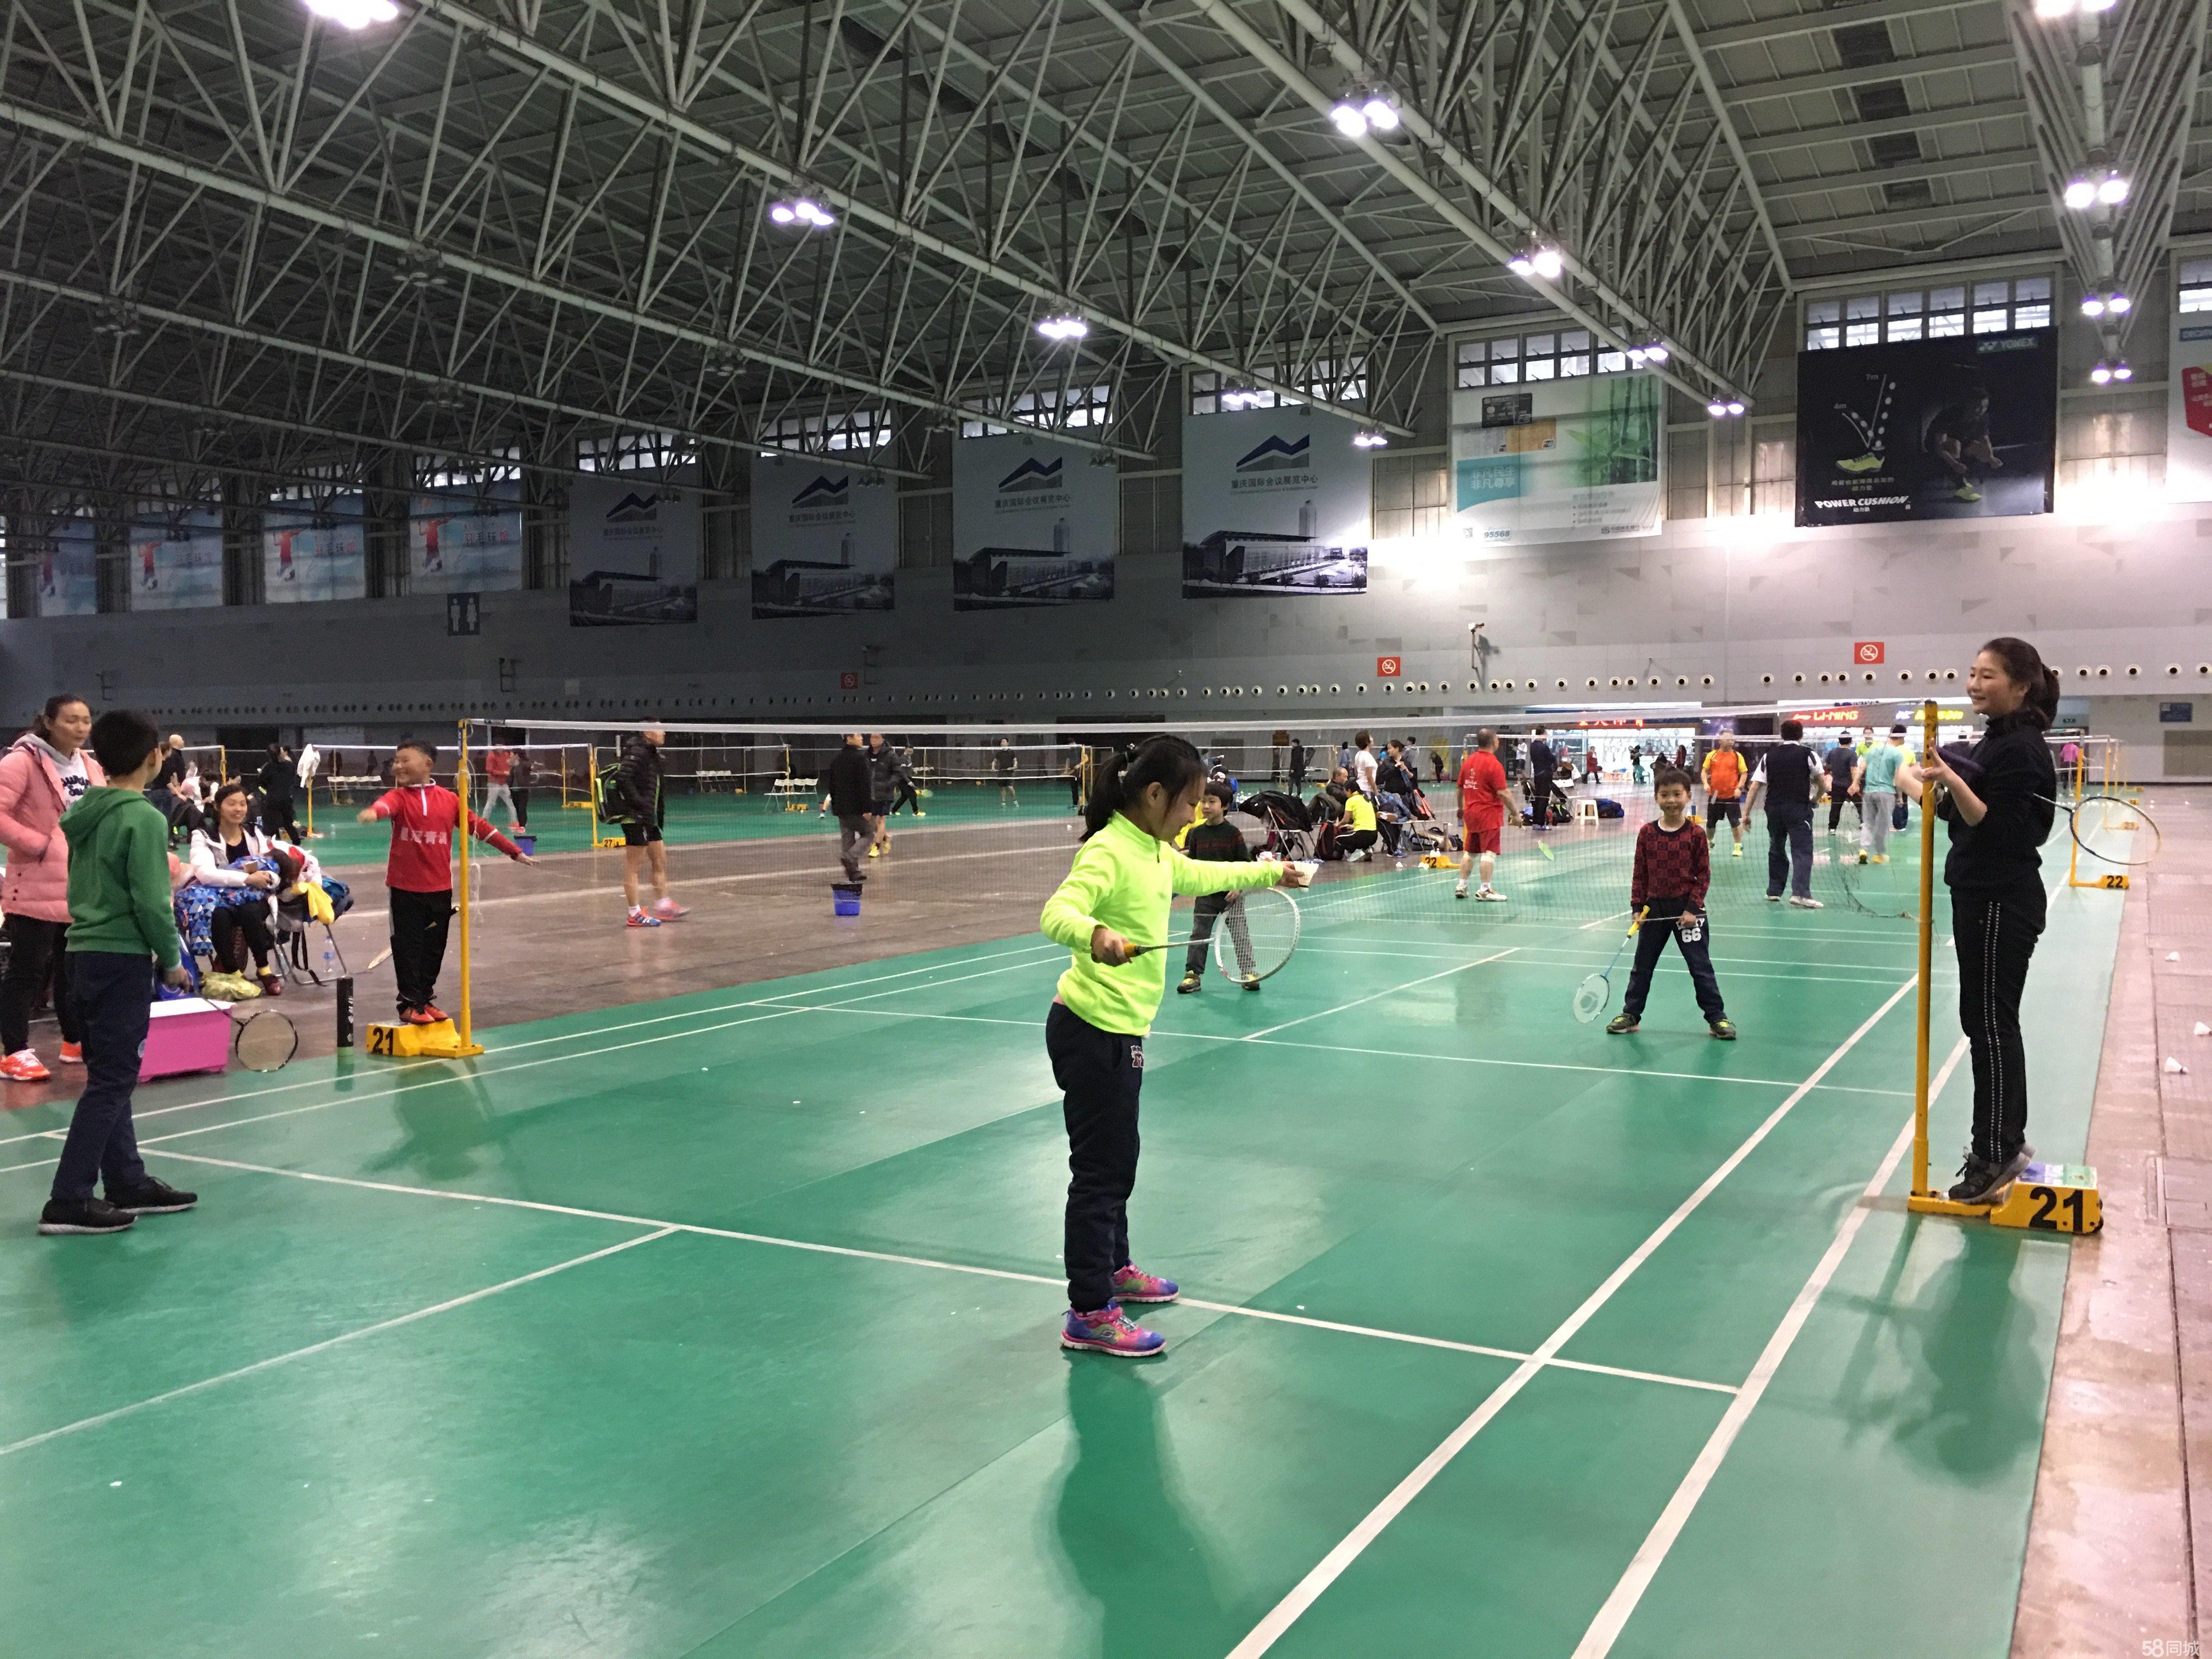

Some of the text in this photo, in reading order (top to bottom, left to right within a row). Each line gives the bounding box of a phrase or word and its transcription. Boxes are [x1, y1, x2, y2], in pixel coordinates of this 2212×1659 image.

[1471, 465, 1516, 479] 非凡民生
[1231, 474, 1318, 489] 重庆国际会议展览中心
[1814, 495, 1909, 509] POWER CUSHION
[1483, 530, 1510, 539] 95568
[1813, 710, 1859, 720] LI-NING
[603, 839, 613, 848] 27
[2106, 875, 2124, 888] 22
[1681, 927, 1702, 943] 66
[371, 1026, 394, 1056] 21
[2028, 1186, 2085, 1233] 21
